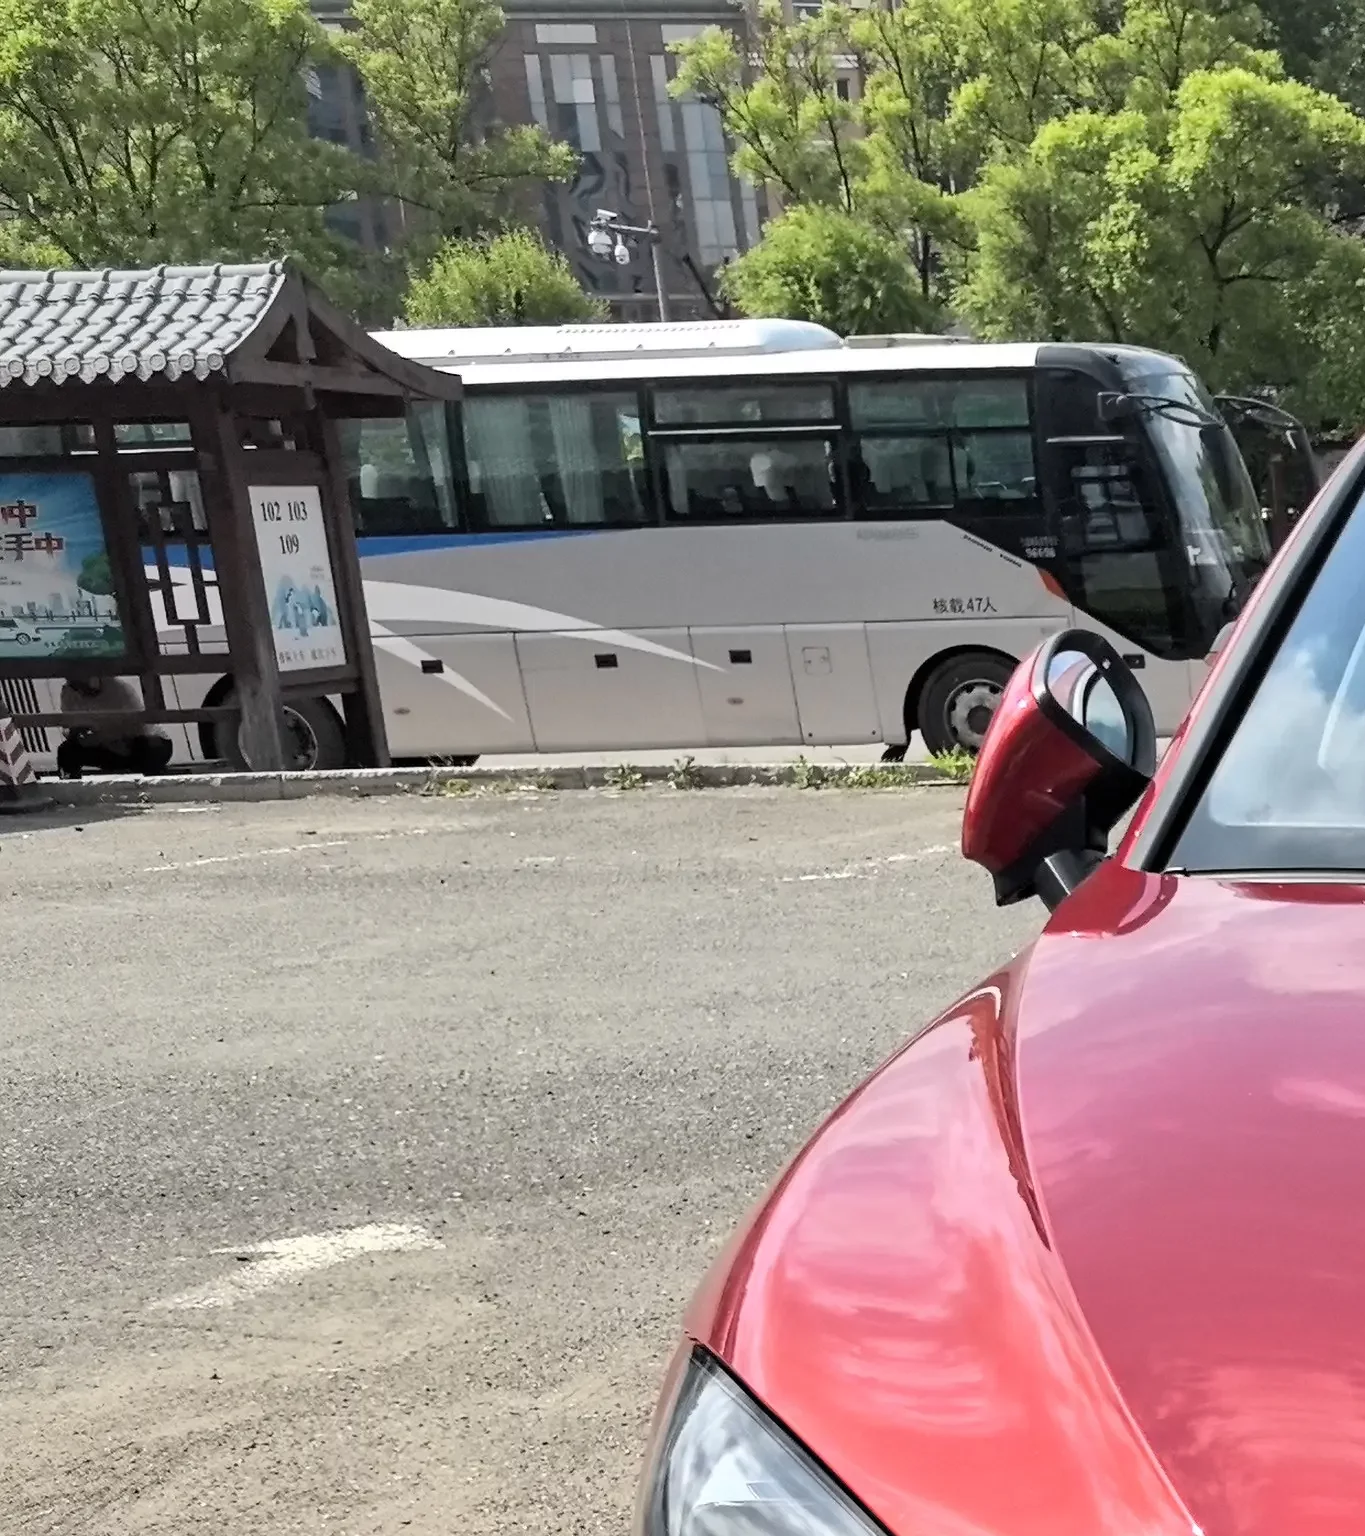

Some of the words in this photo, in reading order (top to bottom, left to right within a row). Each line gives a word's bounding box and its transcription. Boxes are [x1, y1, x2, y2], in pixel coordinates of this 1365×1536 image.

[260, 501, 283, 523] 102
[287, 500, 309, 522] 103
[0, 532, 65, 563] 手中
[279, 533, 301, 555] 109
